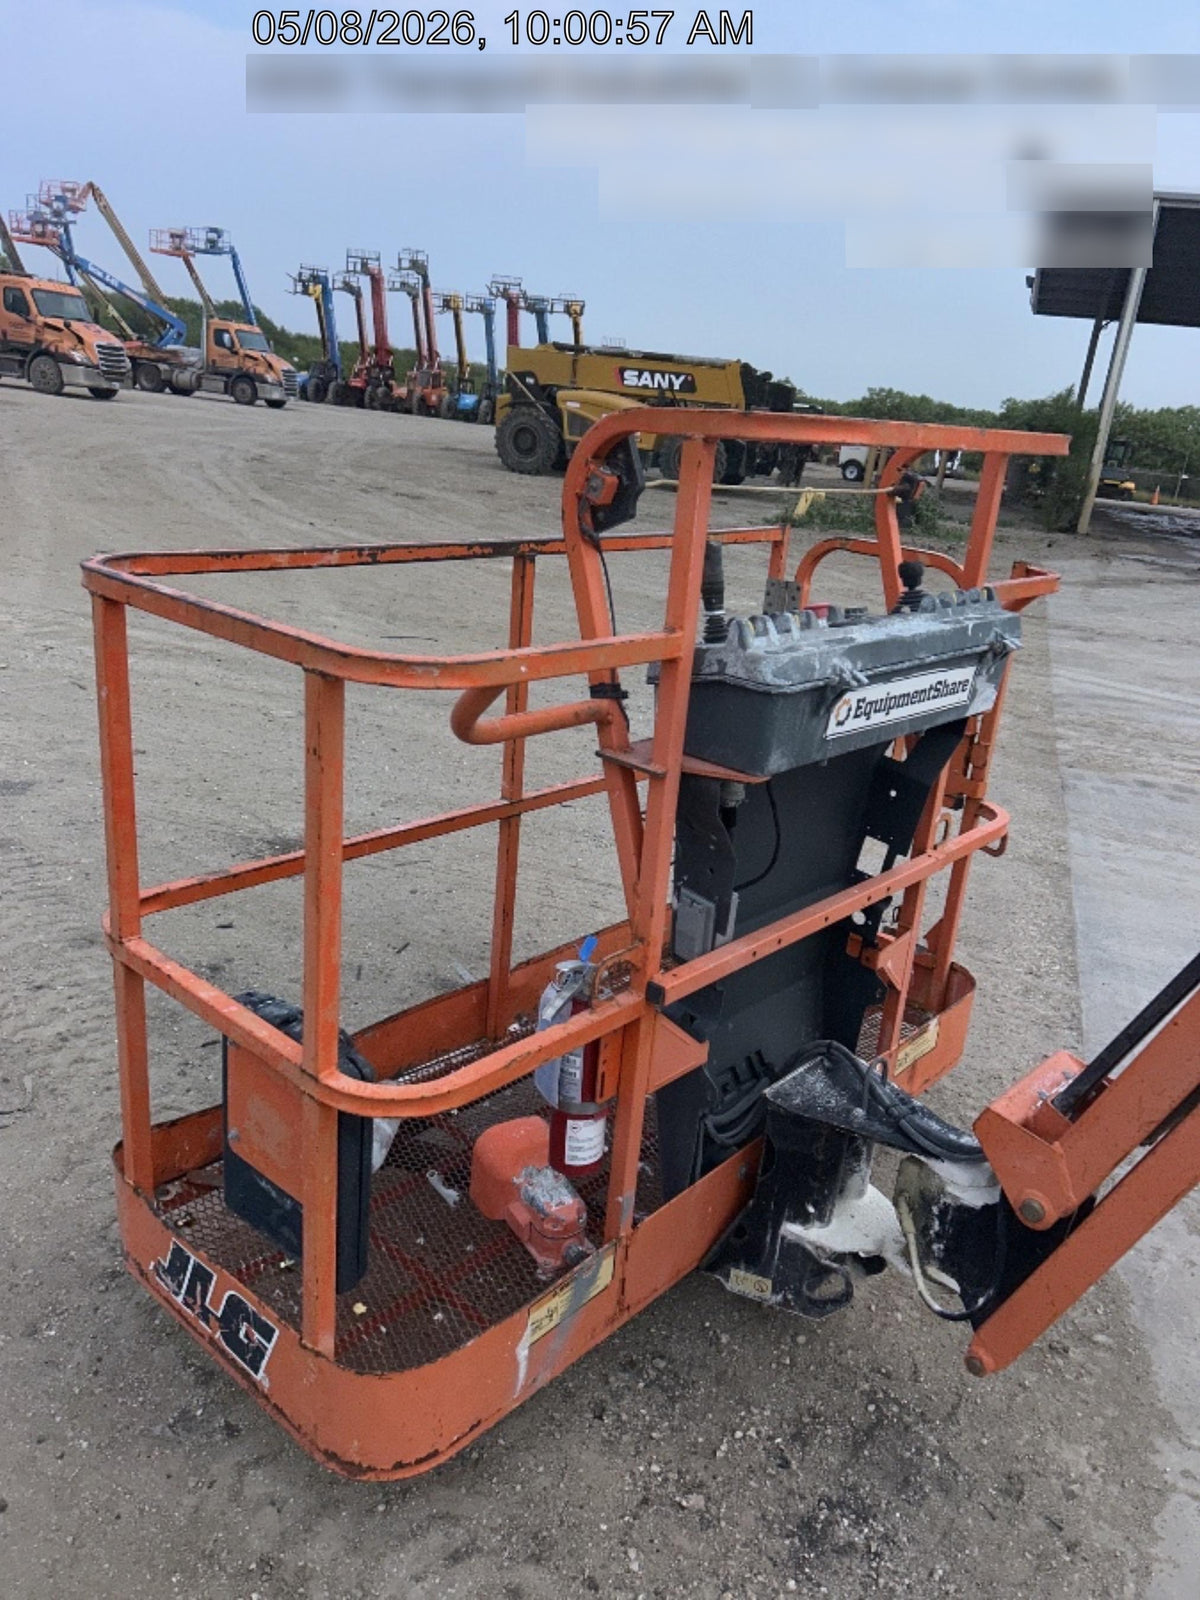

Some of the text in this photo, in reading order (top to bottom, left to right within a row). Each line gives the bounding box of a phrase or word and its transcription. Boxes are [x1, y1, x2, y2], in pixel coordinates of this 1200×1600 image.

[622, 369, 686, 391] SANY
[853, 678, 970, 720] EquipmentShare
[150, 1237, 279, 1380] JLG
